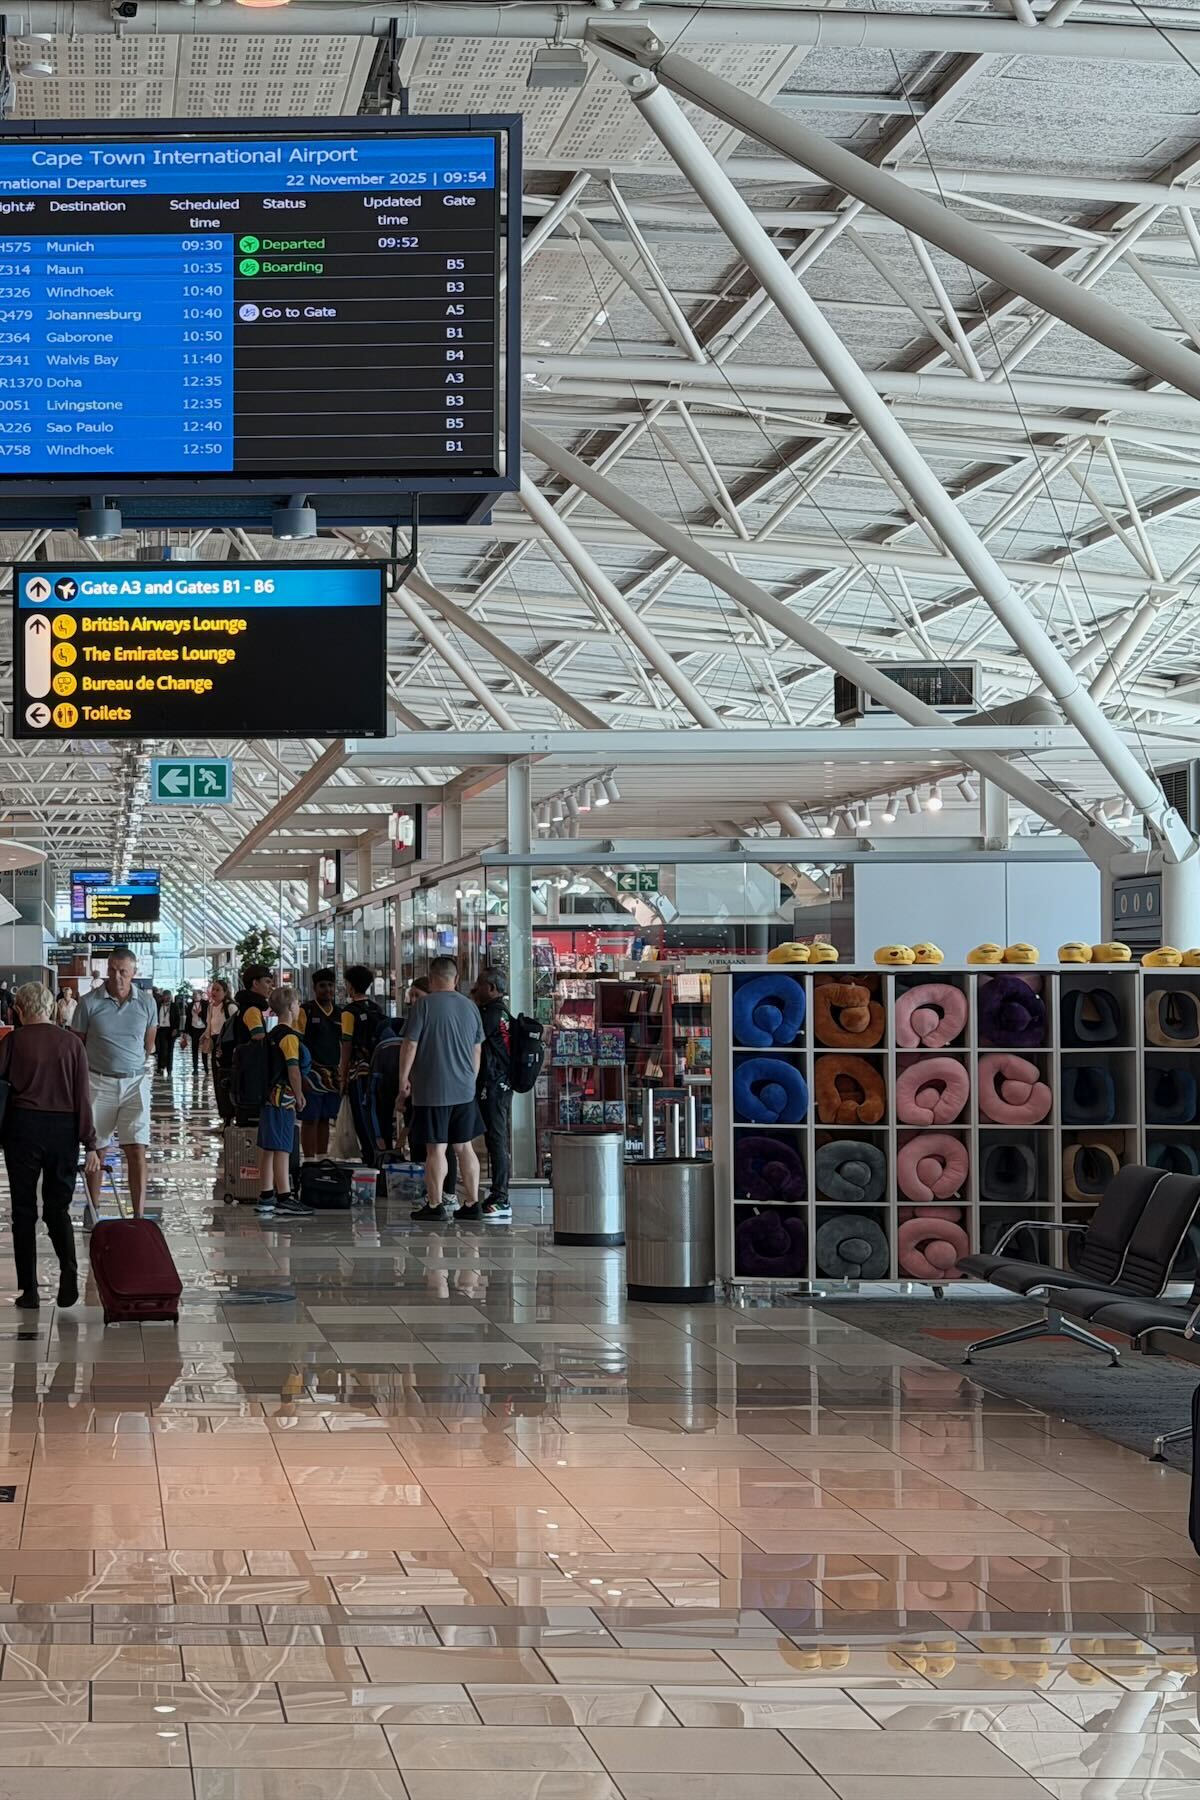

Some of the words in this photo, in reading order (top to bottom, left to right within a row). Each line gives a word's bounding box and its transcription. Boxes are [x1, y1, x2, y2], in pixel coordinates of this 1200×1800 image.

[32, 150, 83, 168] Cape
[90, 151, 145, 165] Town
[153, 148, 281, 165] International
[289, 147, 358, 165] Airport
[67, 177, 147, 191] Departures
[287, 176, 304, 186] 22
[310, 174, 384, 185] November
[390, 173, 427, 184] 2025
[443, 172, 486, 183] 09:54
[50, 200, 126, 212] Destination
[170, 199, 240, 210] Scheduled
[263, 199, 306, 209] Status
[363, 197, 421, 210] Updated
[443, 196, 476, 206] Gate
[190, 217, 220, 228] time
[377, 215, 408, 225] time
[47, 241, 94, 252] Munich
[182, 240, 222, 251] 09:30
[262, 239, 325, 252] Departed
[378, 238, 419, 248] 09:52
[47, 265, 83, 275] Maun
[183, 263, 222, 274] 10:35
[262, 262, 323, 275] Boarding
[447, 260, 465, 270] B5
[47, 286, 113, 298] Windhoek
[183, 285, 222, 296] 10:40
[447, 282, 464, 292] B3
[47, 309, 141, 322] Johannesburg
[183, 308, 222, 319] 10:40
[262, 308, 282, 318] Go
[286, 308, 300, 318] to
[304, 307, 336, 318] Gate
[446, 305, 465, 315] A5
[47, 332, 113, 342] Gaborone
[183, 331, 222, 341] 10:50
[447, 328, 464, 338] B1
[47, 354, 91, 365] Walvis
[94, 354, 119, 368] Bay
[183, 353, 222, 364] 11:40
[447, 350, 464, 360] B4
[47, 377, 82, 388] Doha
[183, 375, 222, 386] 12:35
[445, 373, 464, 383] A3
[47, 399, 123, 412] Livingstone
[183, 398, 222, 409] 12:35
[446, 396, 464, 406] B3
[47, 422, 72, 433] Sao
[76, 422, 113, 433] Paulo
[183, 421, 222, 432] 12:40
[446, 418, 464, 429] B5
[47, 444, 114, 455] Windhoek
[183, 443, 222, 454] 12:50
[446, 441, 463, 451] B1
[81, 581, 118, 594] Gate
[120, 581, 141, 594] A3
[144, 580, 169, 594] and
[176, 580, 220, 593] Gates
[223, 580, 240, 593] B1
[254, 580, 275, 593] B6
[82, 617, 129, 632] British
[131, 617, 191, 635] Airways
[193, 617, 247, 635] Lounge
[82, 647, 110, 662] The
[114, 646, 179, 661] Emirates
[182, 647, 235, 664] Lounge
[82, 677, 133, 691] Bureau
[136, 676, 154, 691] de
[157, 676, 213, 694] Change
[82, 706, 131, 721] Toilets
[72, 934, 115, 942] ICONS
